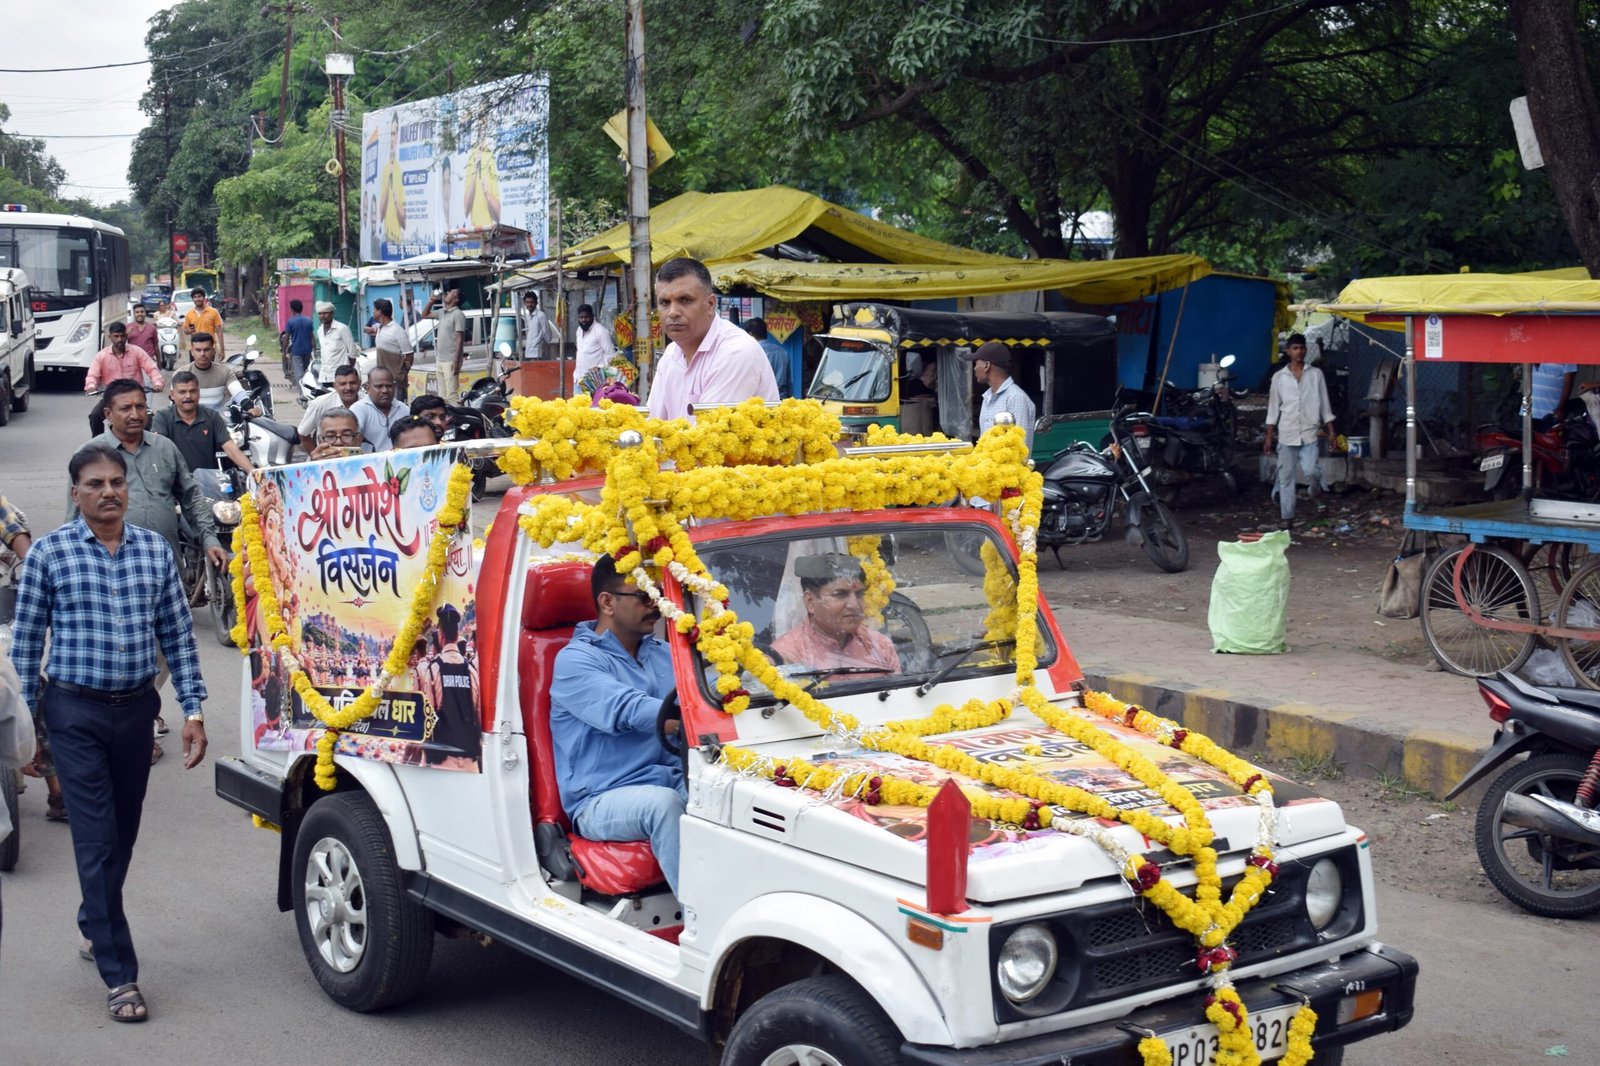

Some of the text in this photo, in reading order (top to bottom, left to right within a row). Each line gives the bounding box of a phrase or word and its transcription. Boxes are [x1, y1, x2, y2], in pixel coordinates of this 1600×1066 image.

[298, 466, 420, 557] श्री गणेश
[316, 533, 402, 599] विसर्जन
[391, 699, 417, 724] धार
[1249, 1015, 1295, 1051] 82
